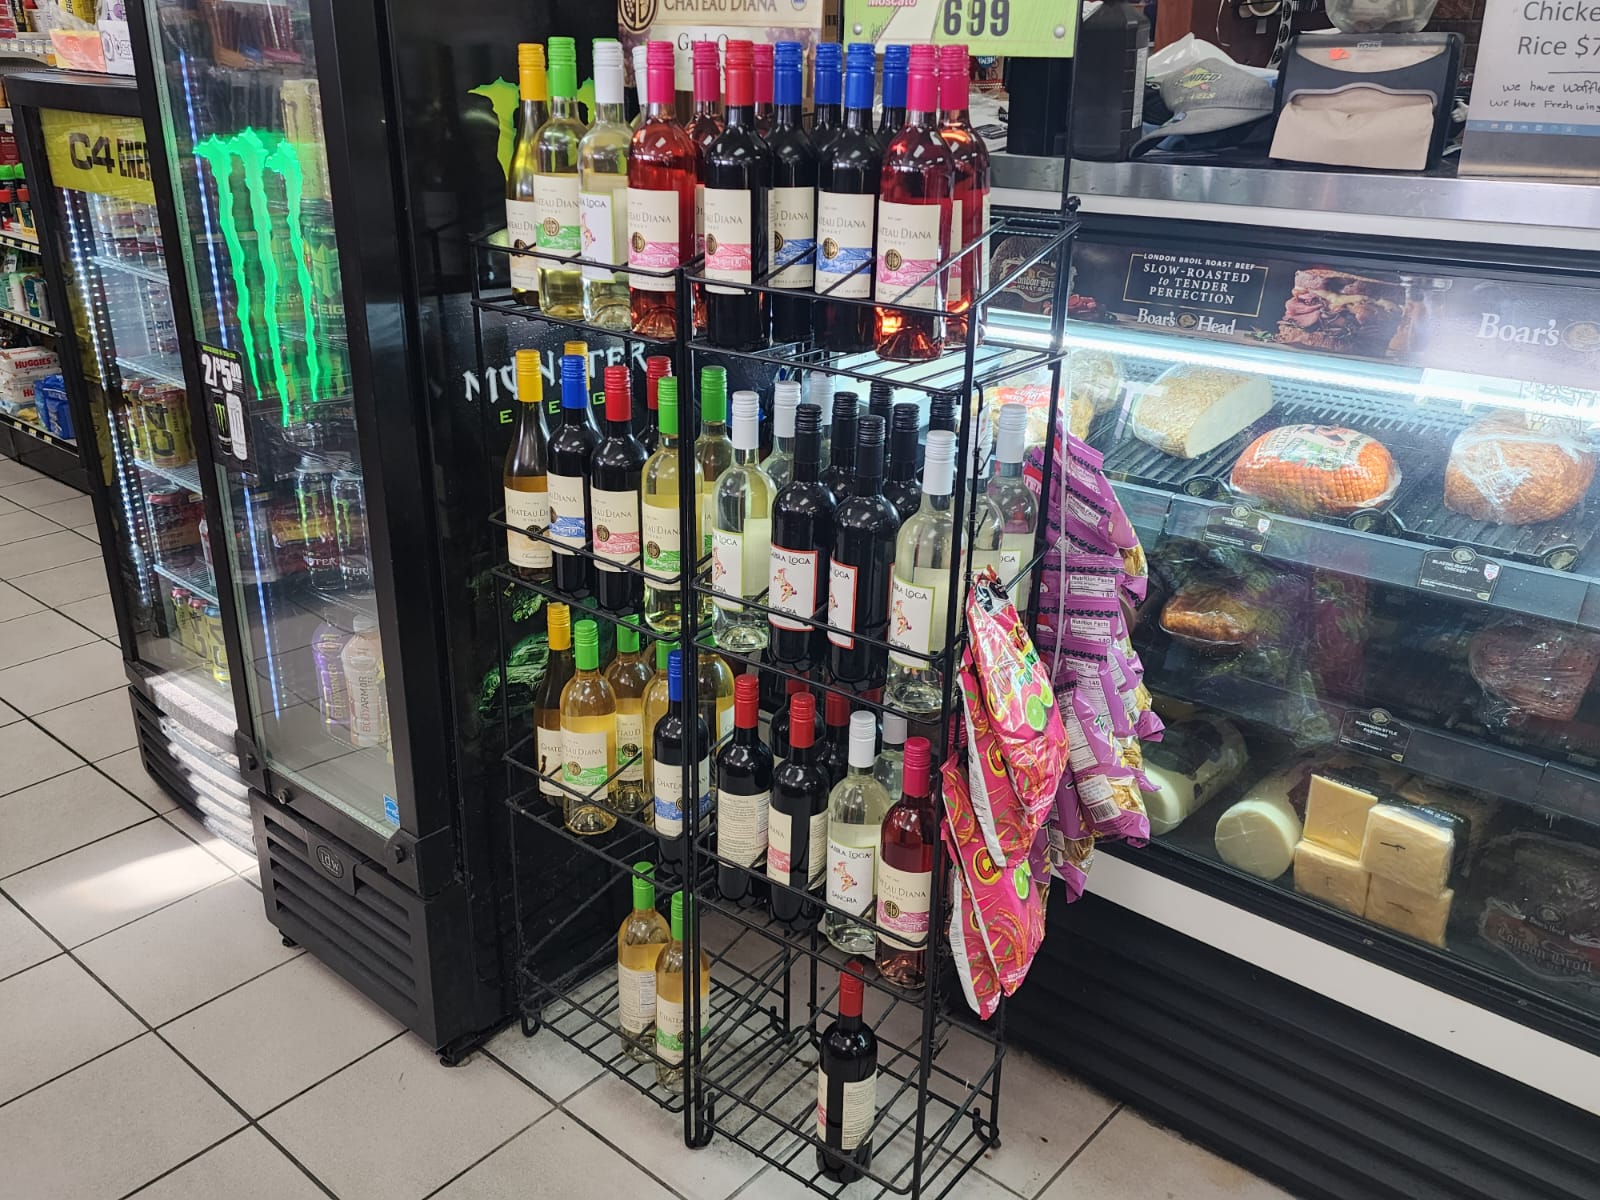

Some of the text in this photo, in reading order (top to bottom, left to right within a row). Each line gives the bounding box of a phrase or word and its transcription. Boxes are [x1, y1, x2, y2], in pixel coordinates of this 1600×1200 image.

[1523, 1, 1600, 22] Chicke
[1517, 36, 1567, 56] Rice
[1530, 80, 1555, 93] have
[69, 131, 114, 174] C4
[641, 212, 672, 224] DIANA
[714, 212, 743, 225] DIANA
[780, 210, 809, 221] DIANA
[836, 217, 866, 229] DIANA
[901, 227, 932, 240] DIANA
[1143, 253, 1256, 271] LONDON BROIL ROAST BEEF
[1143, 263, 1250, 284] SLOW-ROASTED
[1158, 276, 1229, 293] to TENDER
[1149, 286, 1236, 305] PERFECTION
[1136, 307, 1237, 336] Boar's Head
[1476, 312, 1560, 347] Boar's
[14, 357, 51, 369] HUGGIES
[554, 492, 577, 504] DIANA
[507, 505, 538, 517] CHATEAU
[606, 509, 632, 519] DIANA
[657, 525, 680, 536] DIAN
[718, 535, 738, 546] LOCA
[788, 554, 811, 566] LOCA
[905, 588, 928, 601] LOCA
[358, 675, 372, 733] BODYARMOR
[577, 748, 603, 757] DIANA
[849, 850, 872, 860] LOCA
[832, 890, 858, 905] SANGRIA
[898, 887, 927, 899] DIANA
